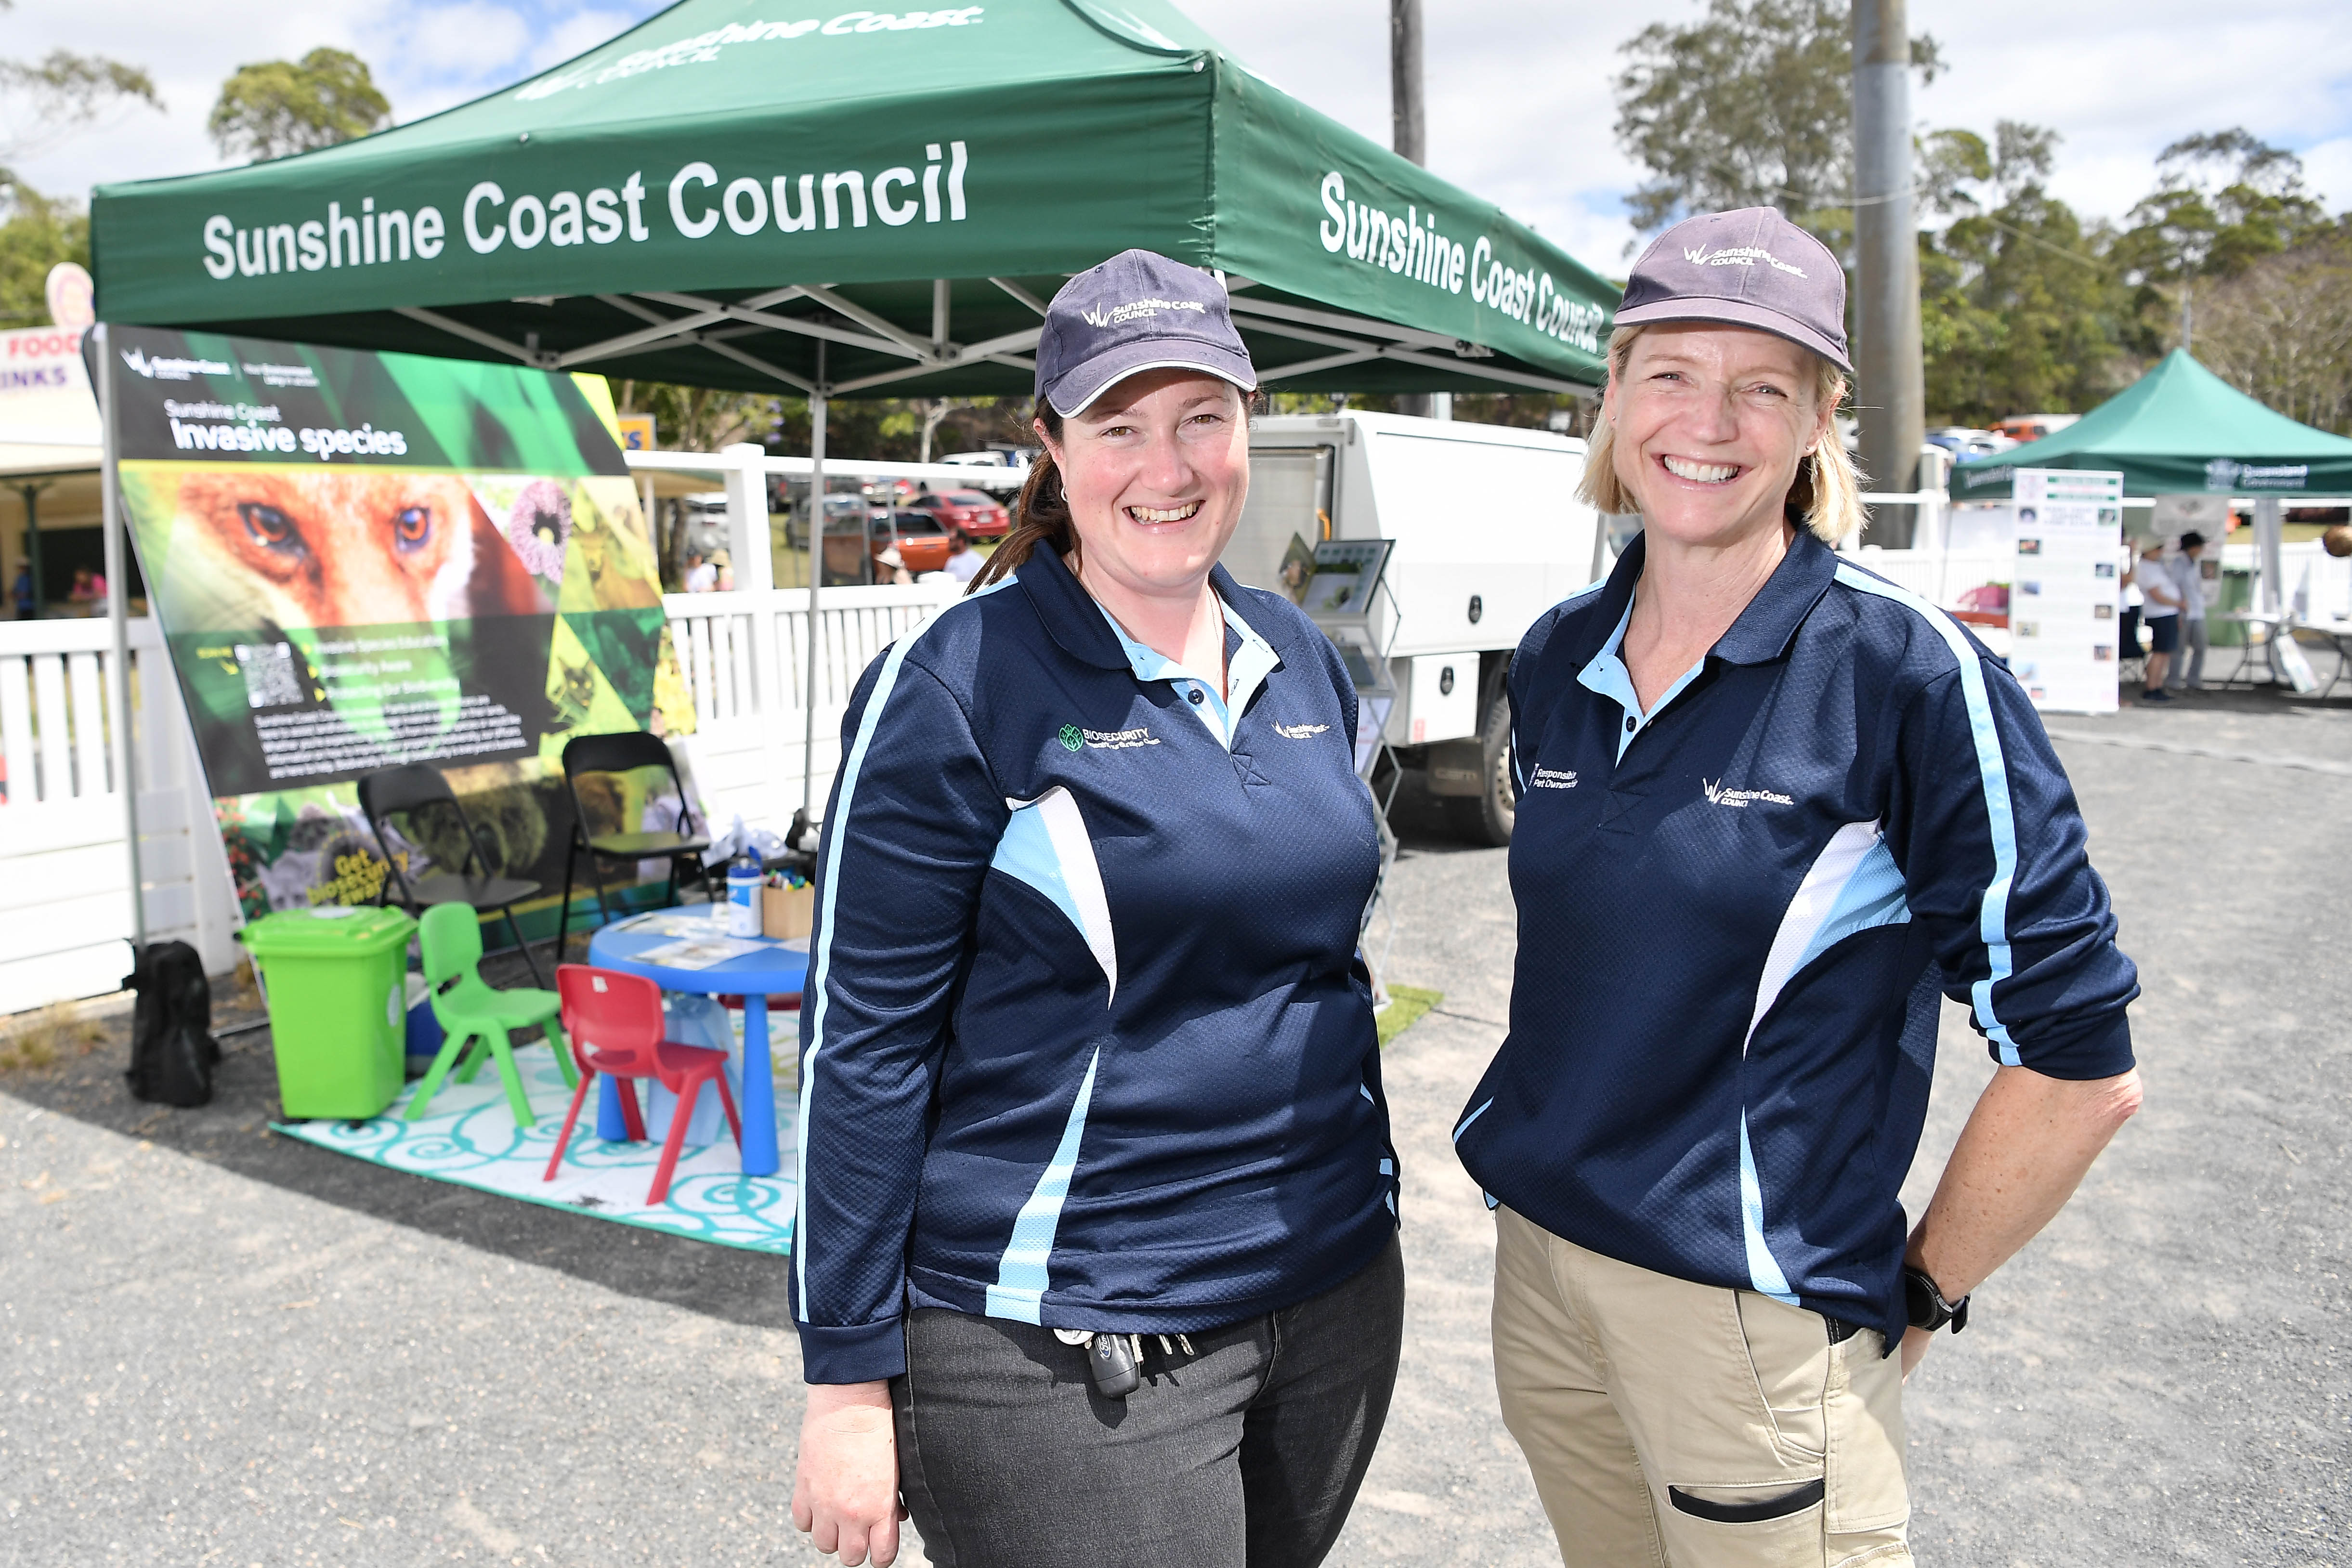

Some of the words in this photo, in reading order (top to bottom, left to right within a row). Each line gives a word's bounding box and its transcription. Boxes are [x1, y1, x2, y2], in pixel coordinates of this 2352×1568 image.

[821, 5, 984, 36] Coast
[202, 196, 446, 280] Sunshine
[462, 170, 649, 254] Coast
[667, 140, 968, 239] Council
[1320, 171, 1465, 295] Sunshine
[1470, 235, 1536, 326] Coast
[1710, 256, 1755, 266] COUNCIL
[1113, 308, 1158, 324] COUNCIL
[170, 417, 297, 453] Invasive
[299, 422, 408, 461] species
[1082, 728, 1149, 742] BIOSECURITY
[1533, 779, 1545, 788] Pet
[1760, 790, 1791, 805] Coast
[334, 847, 373, 877] Get
